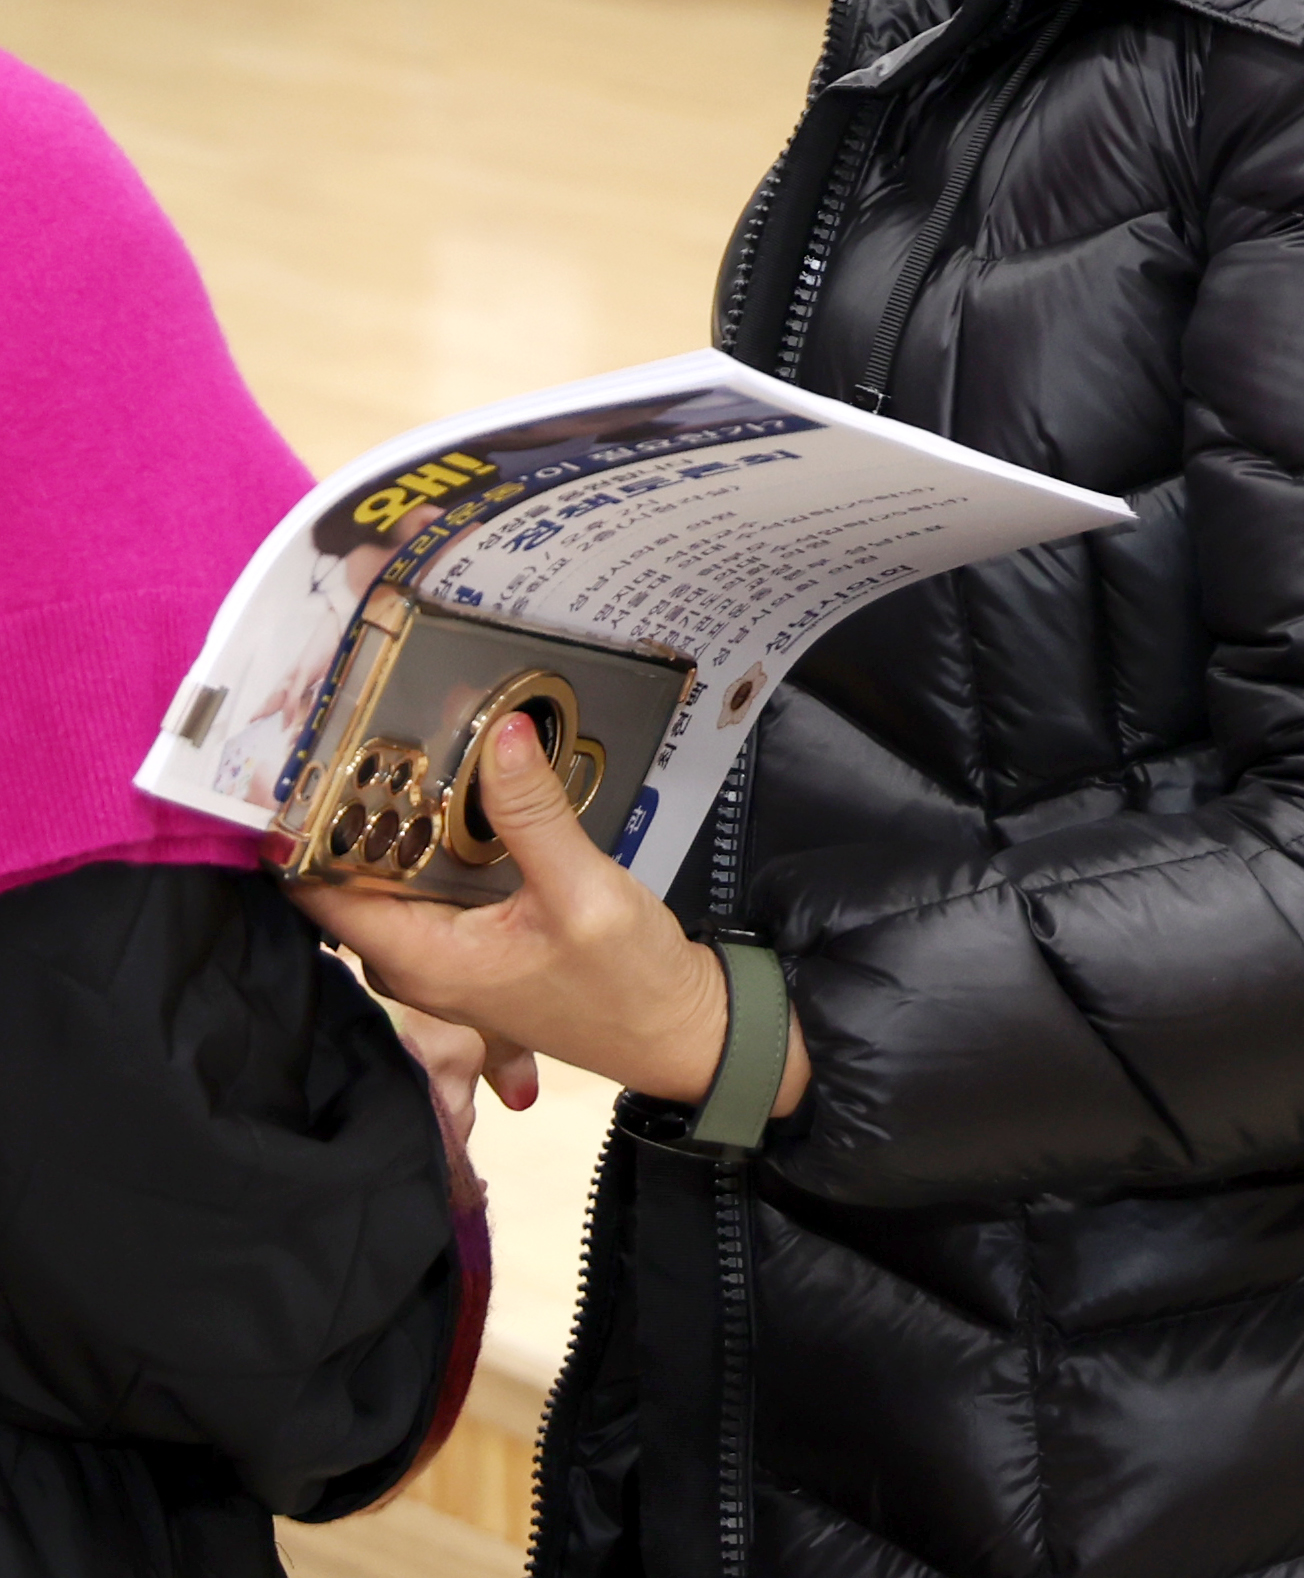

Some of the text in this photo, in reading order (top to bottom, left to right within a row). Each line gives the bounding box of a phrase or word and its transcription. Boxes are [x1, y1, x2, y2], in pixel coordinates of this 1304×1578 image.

[588, 420, 784, 462] 필요한가?
[353, 451, 497, 533] 왜!
[477, 504, 552, 552] 성장을
[557, 458, 694, 502] 응원합니다
[501, 449, 803, 554] 정책토론회
[560, 519, 607, 548] 오후
[620, 498, 659, 517] 2시
[569, 511, 738, 614] 성남시의회 의원
[593, 521, 758, 622] 명지대 석좌교수
[610, 573, 672, 630] 서울대
[677, 543, 727, 569] 의대
[648, 587, 709, 639] 서울대
[712, 554, 762, 582] 의대
[662, 562, 771, 648] 경기도의회
[780, 539, 831, 559] 의원
[697, 541, 770, 576] 학부모
[745, 564, 793, 591] 교장
[657, 681, 708, 771] 최현백
[712, 579, 819, 667] 성남시의회
[827, 554, 878, 576] 의원
